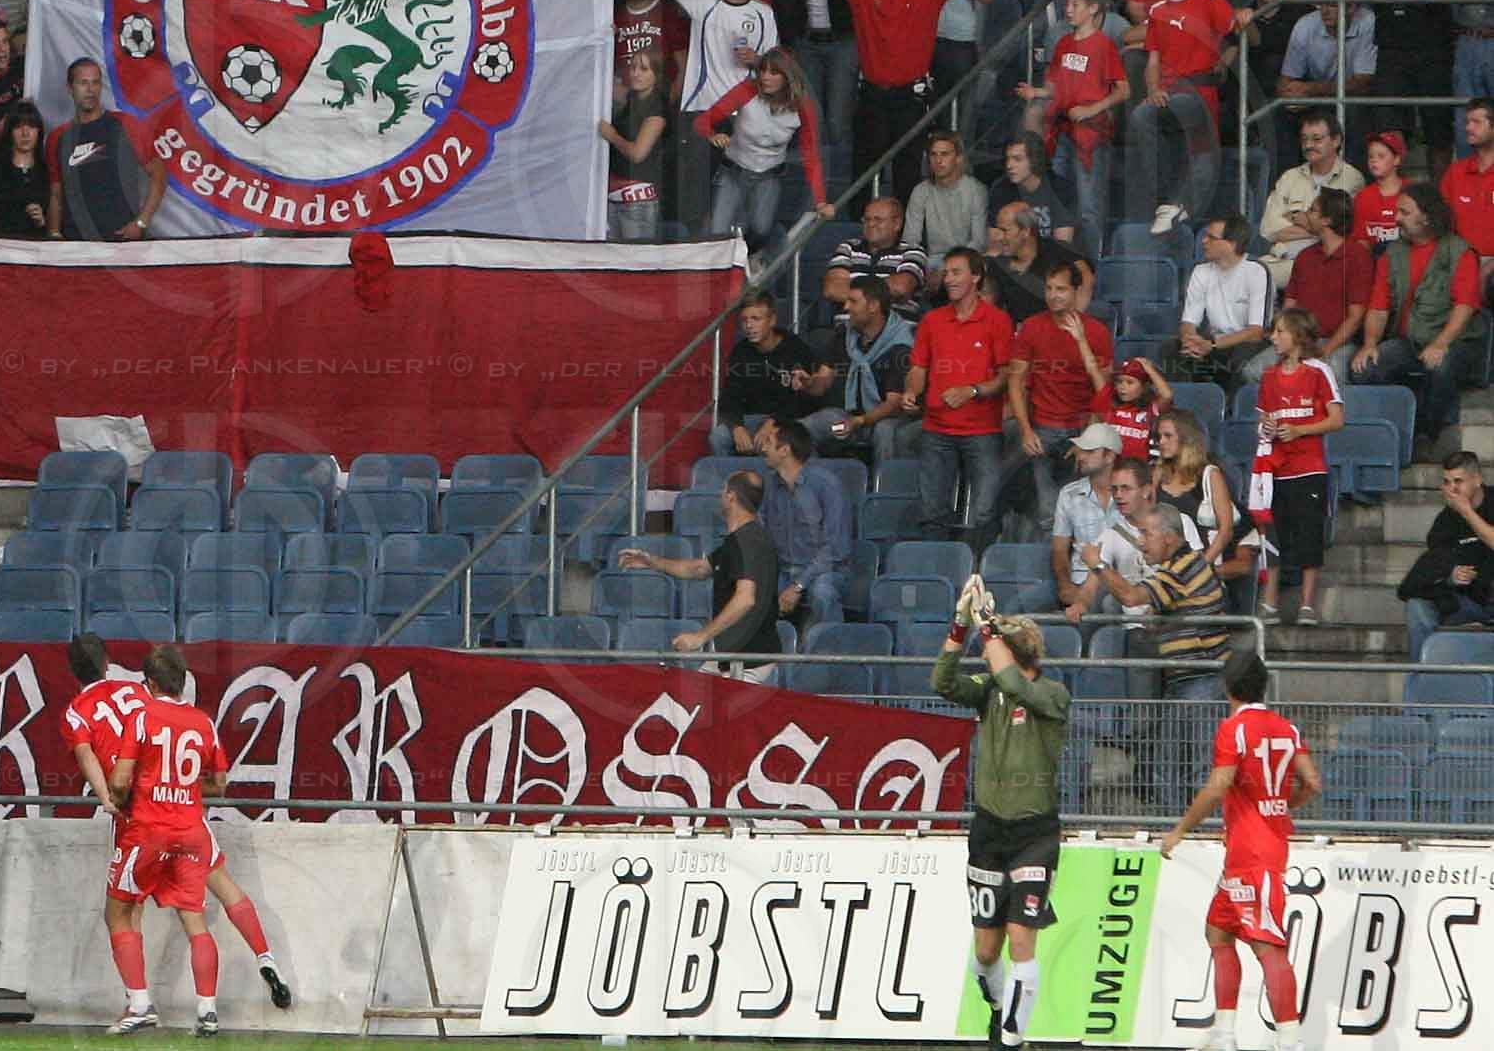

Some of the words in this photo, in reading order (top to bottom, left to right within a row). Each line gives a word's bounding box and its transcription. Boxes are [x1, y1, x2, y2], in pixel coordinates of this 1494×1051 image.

[153, 128, 370, 226] gegründet
[378, 136, 473, 207] 1902
[93, 686, 145, 737] 15
[151, 727, 203, 786] 16
[1254, 738, 1296, 797] 17
[537, 850, 596, 873] JÖBSTL
[666, 851, 727, 874] JÖBSTL
[771, 850, 832, 874] JÖBSTL
[879, 852, 939, 876] JÖBSTL
[506, 857, 923, 1020] JÖBSTL
[1086, 856, 1144, 1034] UMZÜGE
